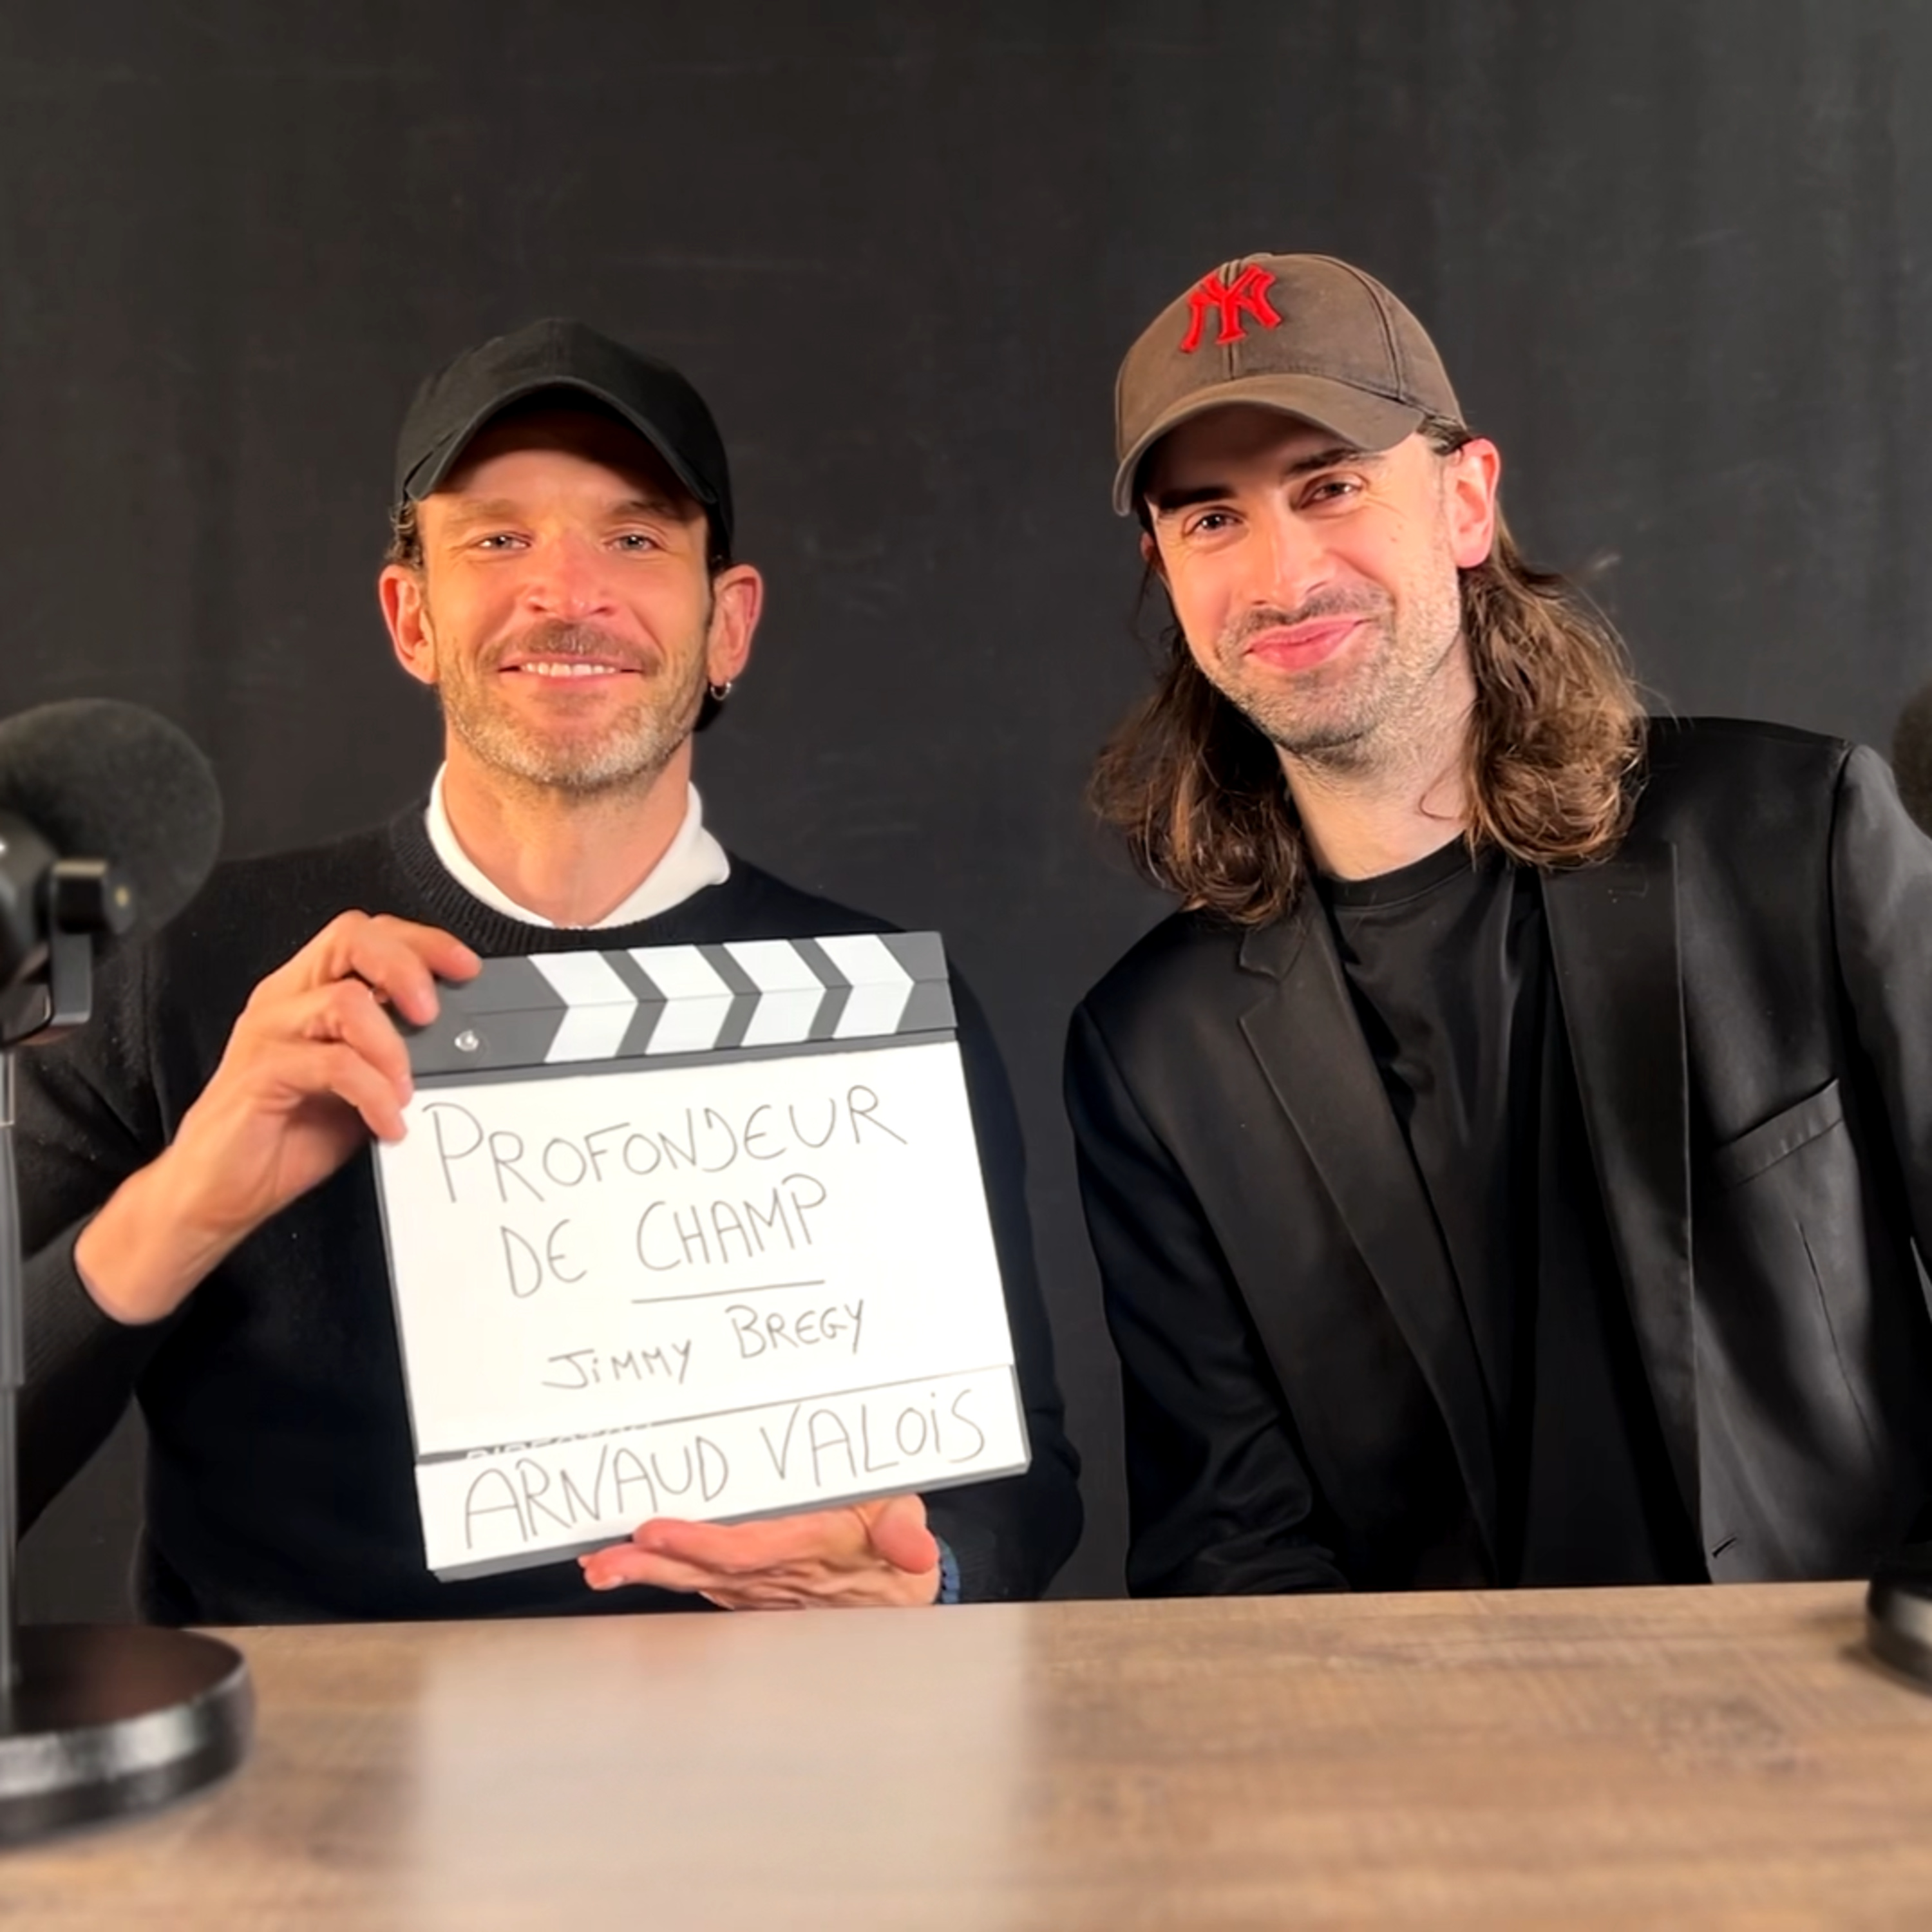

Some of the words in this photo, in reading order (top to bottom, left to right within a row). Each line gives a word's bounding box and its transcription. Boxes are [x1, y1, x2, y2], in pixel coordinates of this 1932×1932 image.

[421, 1084, 907, 1203] PROFONDEUR
[500, 1218, 587, 1298] DE
[636, 1173, 827, 1271] CHAMP
[724, 1299, 864, 1359] BREGY
[464, 1435, 729, 1549] ARNAUD
